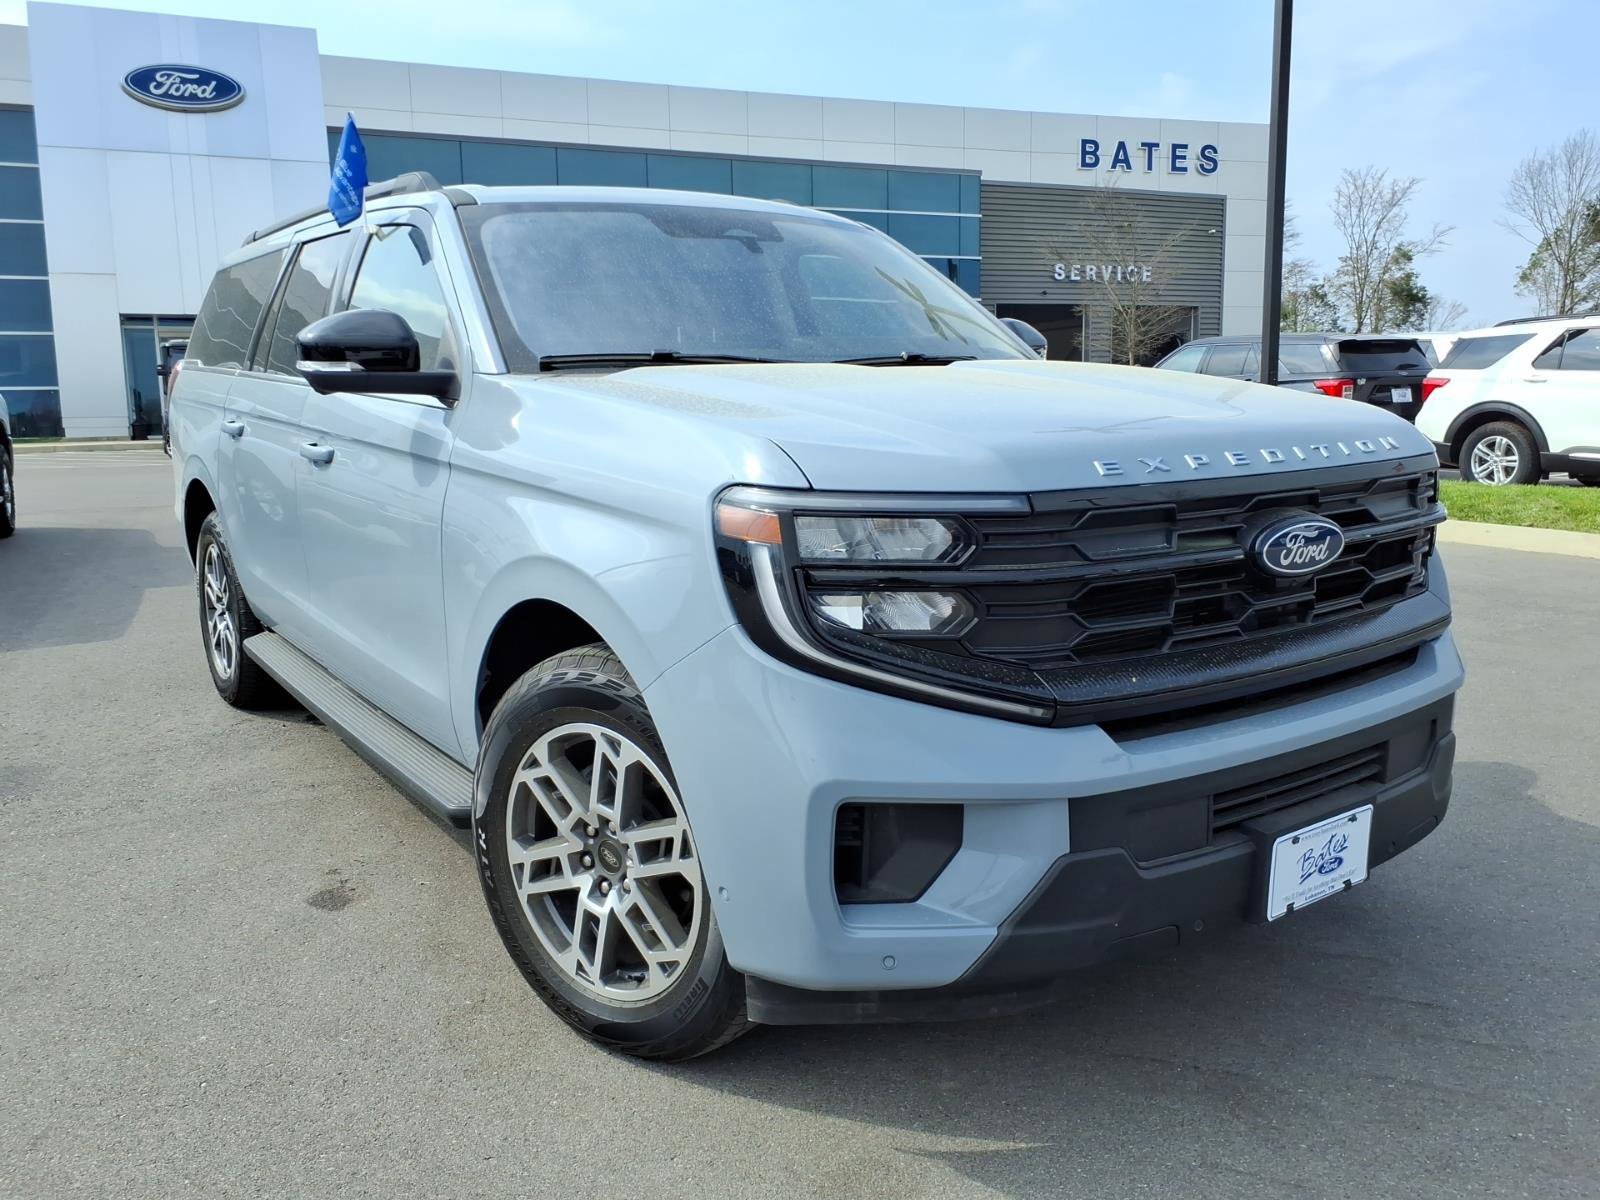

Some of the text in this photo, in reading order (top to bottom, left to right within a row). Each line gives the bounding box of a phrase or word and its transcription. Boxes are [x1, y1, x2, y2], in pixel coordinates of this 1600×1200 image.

[149, 70, 217, 99] Ford
[1079, 138, 1219, 174] BATES
[1053, 263, 1152, 282] SERVICE
[1093, 436, 1400, 476] EXPEDITION
[1280, 530, 1331, 566] Ford
[1297, 833, 1349, 882] Bates
